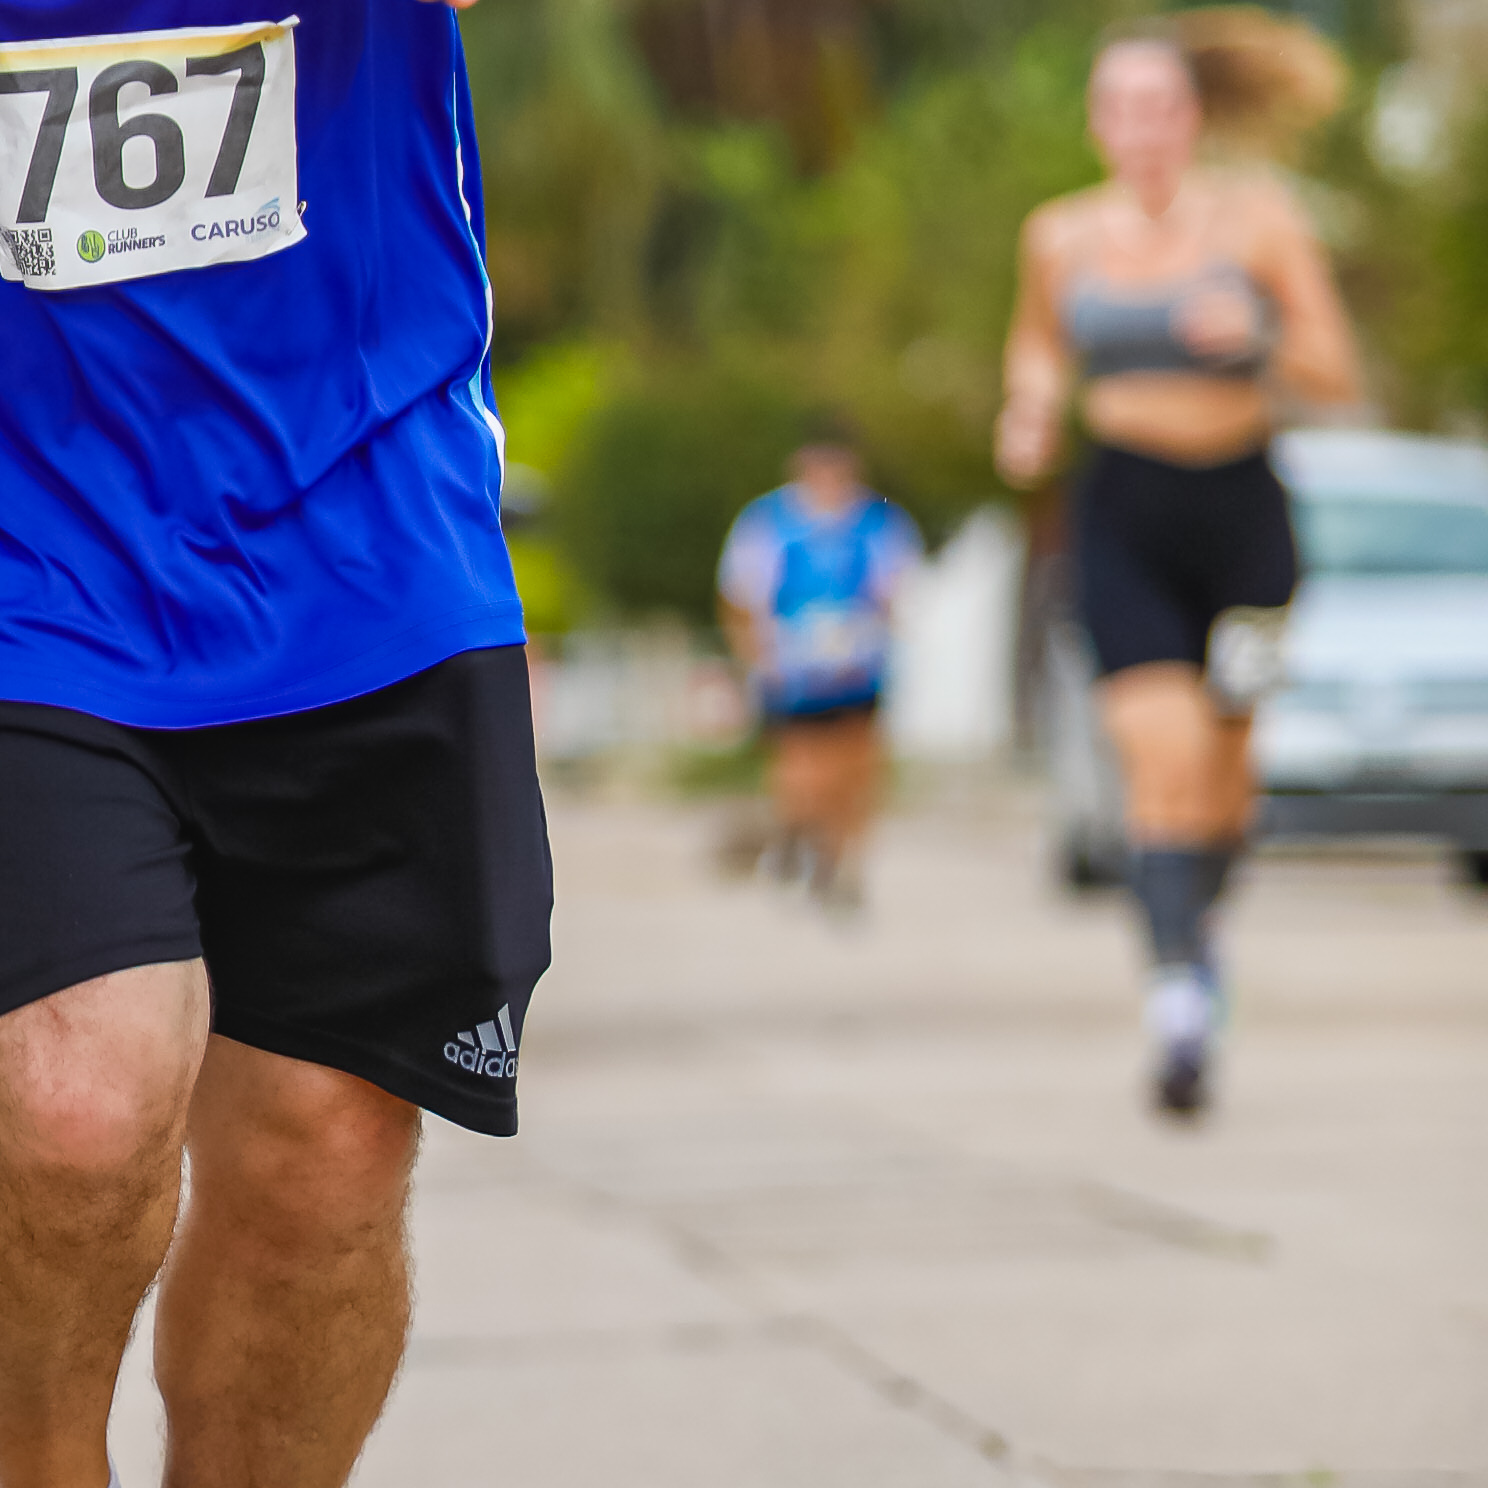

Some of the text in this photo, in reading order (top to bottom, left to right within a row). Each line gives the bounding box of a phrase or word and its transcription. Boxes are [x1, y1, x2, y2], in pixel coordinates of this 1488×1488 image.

[107, 227, 138, 242] CLUB
[191, 211, 280, 241] CARUSO
[108, 234, 166, 255] RUNNER'S
[443, 1042, 518, 1078] adida
